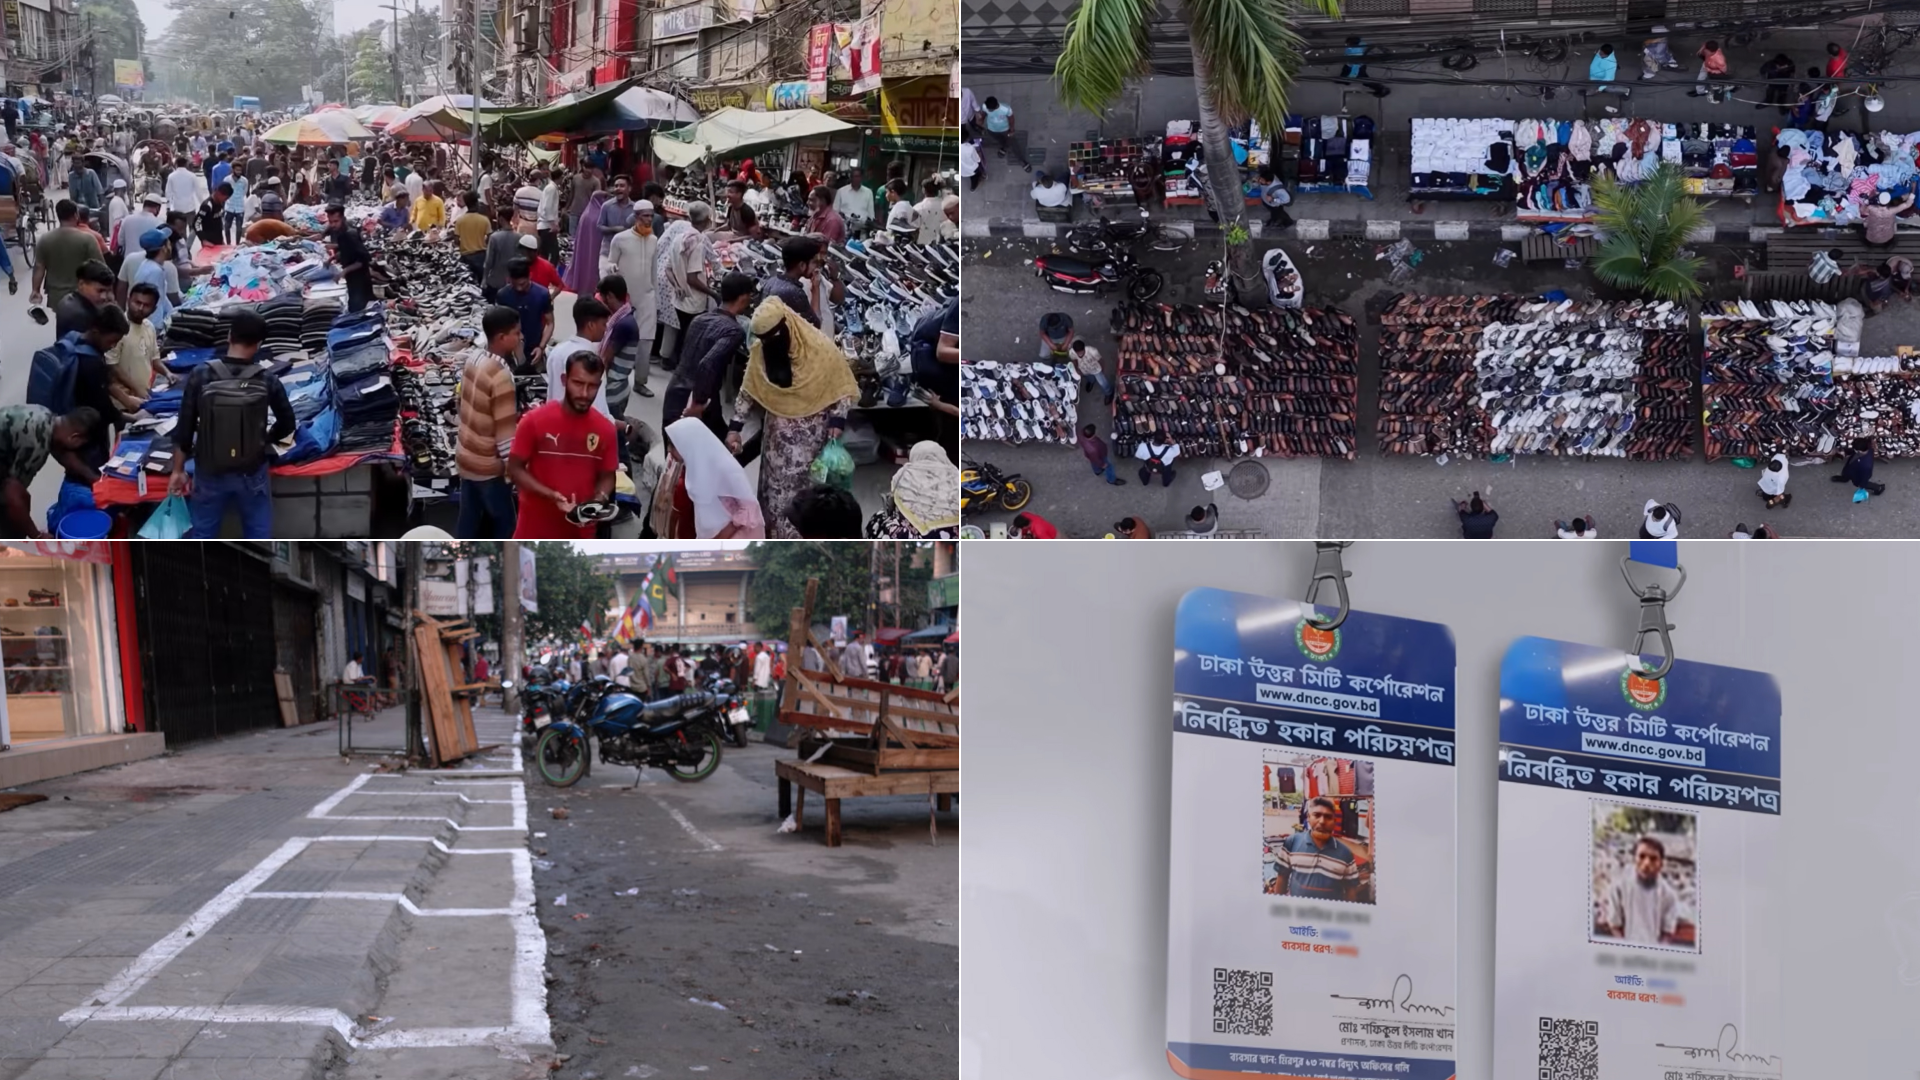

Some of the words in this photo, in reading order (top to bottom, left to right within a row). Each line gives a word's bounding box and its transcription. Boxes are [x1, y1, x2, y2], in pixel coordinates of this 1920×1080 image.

[1197, 654, 1244, 676] ঢাকা
[1247, 656, 1296, 683] উত্তর
[1299, 663, 1343, 689] সিটি
[1346, 673, 1445, 703] কর্পোরেশন
[1260, 687, 1377, 713] www.dncc.gov.bd
[1180, 701, 1270, 740] নিবন্ধিত
[1275, 719, 1336, 746] হকার
[1343, 725, 1455, 763] পরিচয়পত্র
[1522, 703, 1570, 725] ঢাকা
[1573, 705, 1621, 733] উত্তর
[1624, 712, 1668, 738] সিটি
[1671, 723, 1770, 752] কর্পোরেশন
[1585, 735, 1703, 762] www.dncc.gov.bd
[1506, 750, 1595, 789] নিবন্ধিত
[1600, 768, 1662, 796] হকার
[1669, 774, 1780, 812] পরিচয়পত্র
[1289, 926, 1319, 937] আইডি:
[1614, 975, 1644, 987] আইডি:
[1338, 1021, 1358, 1033] মোঃ
[1360, 1021, 1400, 1038] শফিকুল
[1402, 1024, 1434, 1038] ইসলাম
[1436, 1028, 1454, 1039] খান
